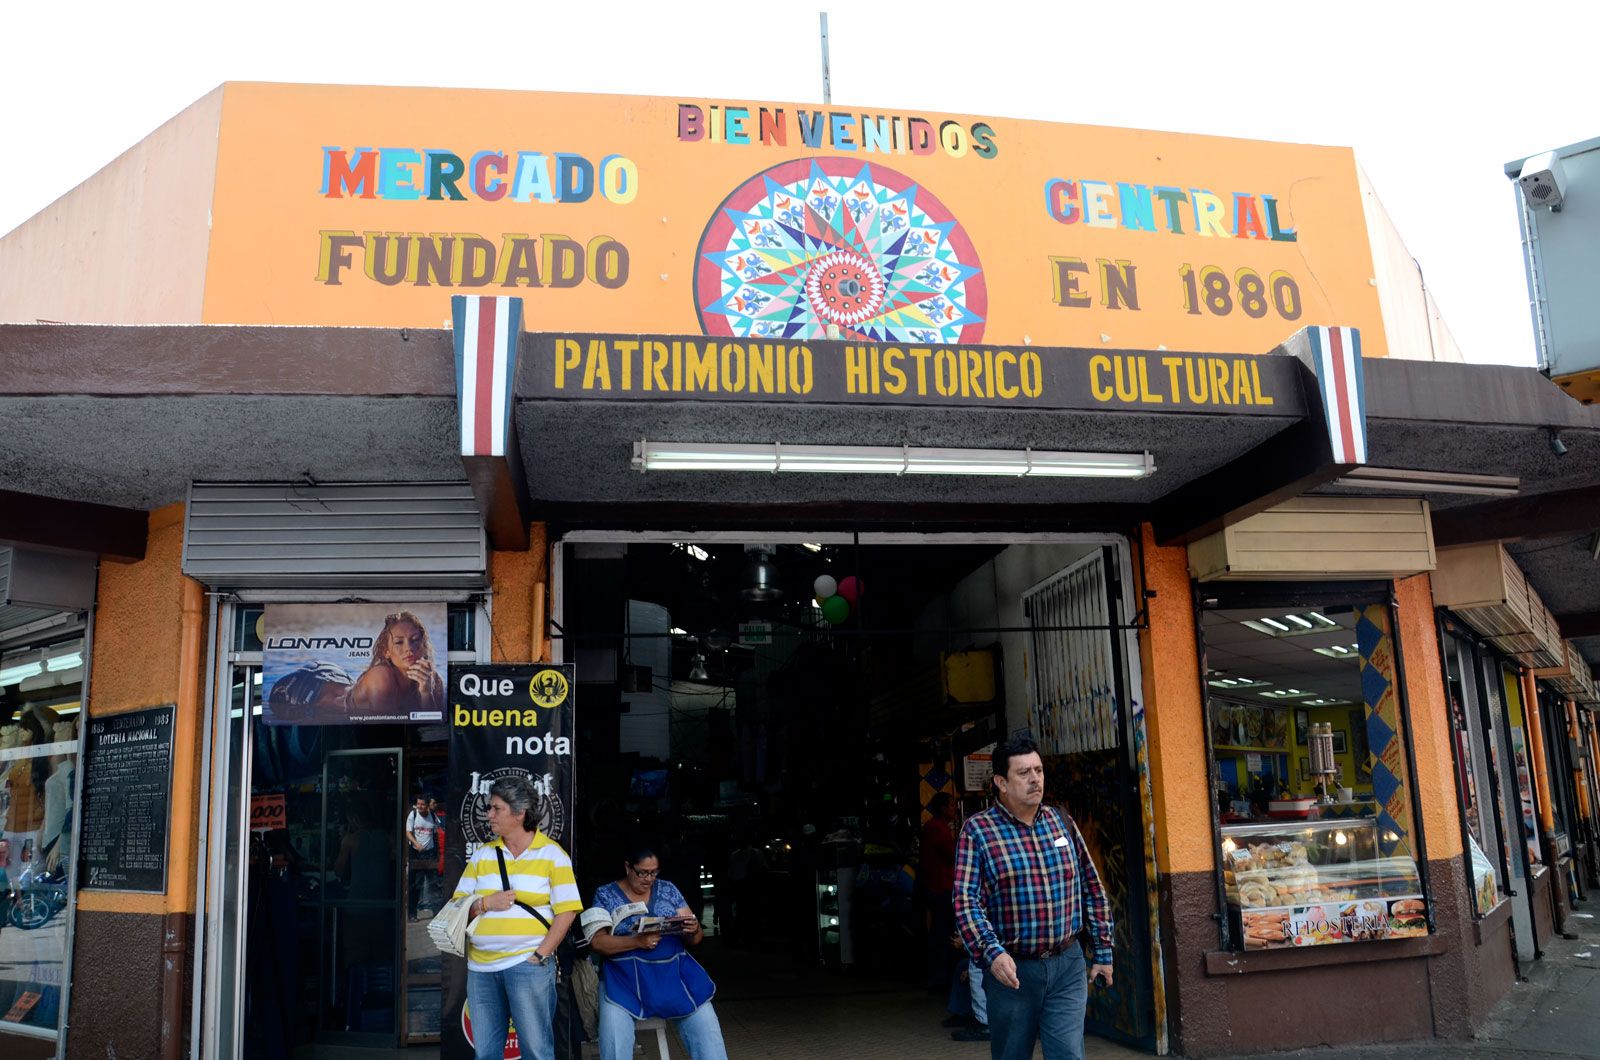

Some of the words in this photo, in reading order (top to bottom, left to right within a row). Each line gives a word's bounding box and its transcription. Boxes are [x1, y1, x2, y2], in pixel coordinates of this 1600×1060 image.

[677, 103, 998, 159] BIENVENIDOS
[318, 146, 639, 204] MERCADO
[1044, 177, 1298, 243] CENTRAL
[314, 230, 630, 290] FUNDADO
[1048, 255, 1140, 311] EN
[1179, 262, 1302, 321] 1880
[554, 338, 813, 395] PATRIMONIO
[846, 346, 1043, 399] HISTORICO
[1089, 354, 1273, 405] CULTURAL
[267, 637, 373, 650] LONTANO
[459, 673, 515, 698] Que
[454, 704, 538, 727] buena
[99, 732, 126, 746] LOTERIA
[127, 728, 158, 742] NACIONAL
[506, 731, 571, 755] nota
[1283, 911, 1394, 938] REPOSTERIA
